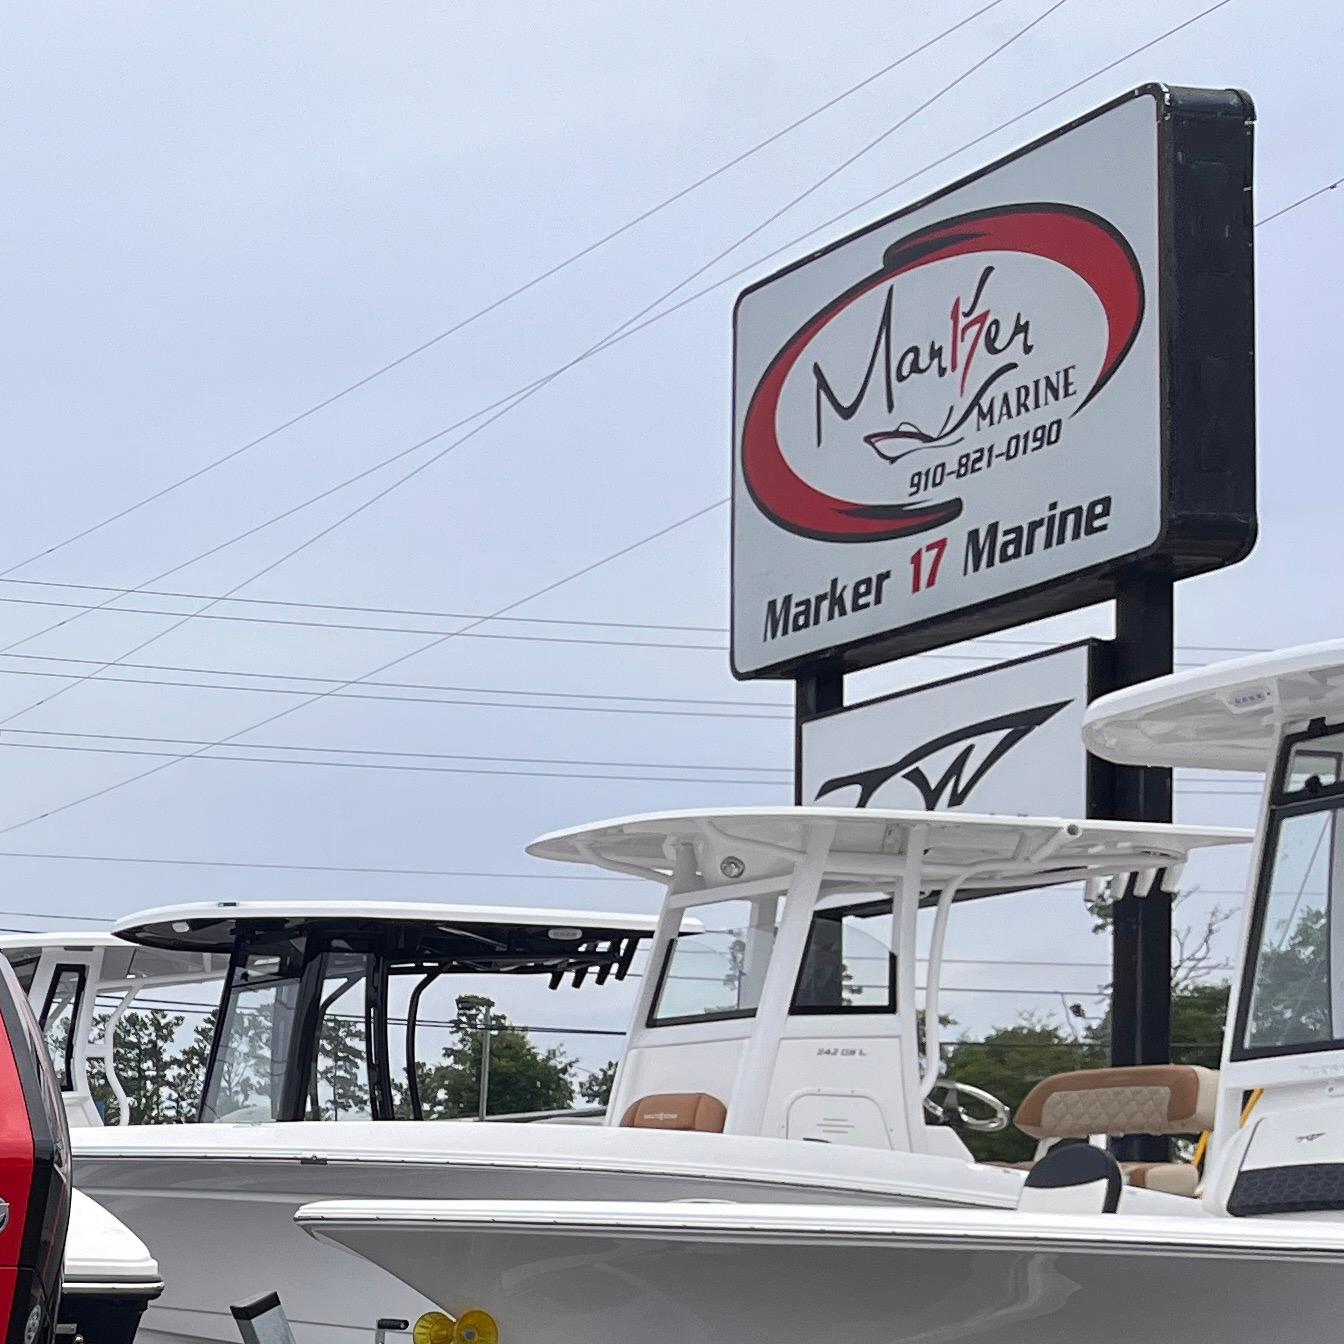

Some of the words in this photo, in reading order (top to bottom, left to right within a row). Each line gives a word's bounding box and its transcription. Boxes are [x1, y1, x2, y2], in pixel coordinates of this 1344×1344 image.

[976, 364, 1078, 432] MARINE
[908, 418, 1063, 497] 910-821-0190
[763, 569, 892, 643] Marker
[909, 537, 949, 594] 17
[963, 496, 1113, 577] Marine
